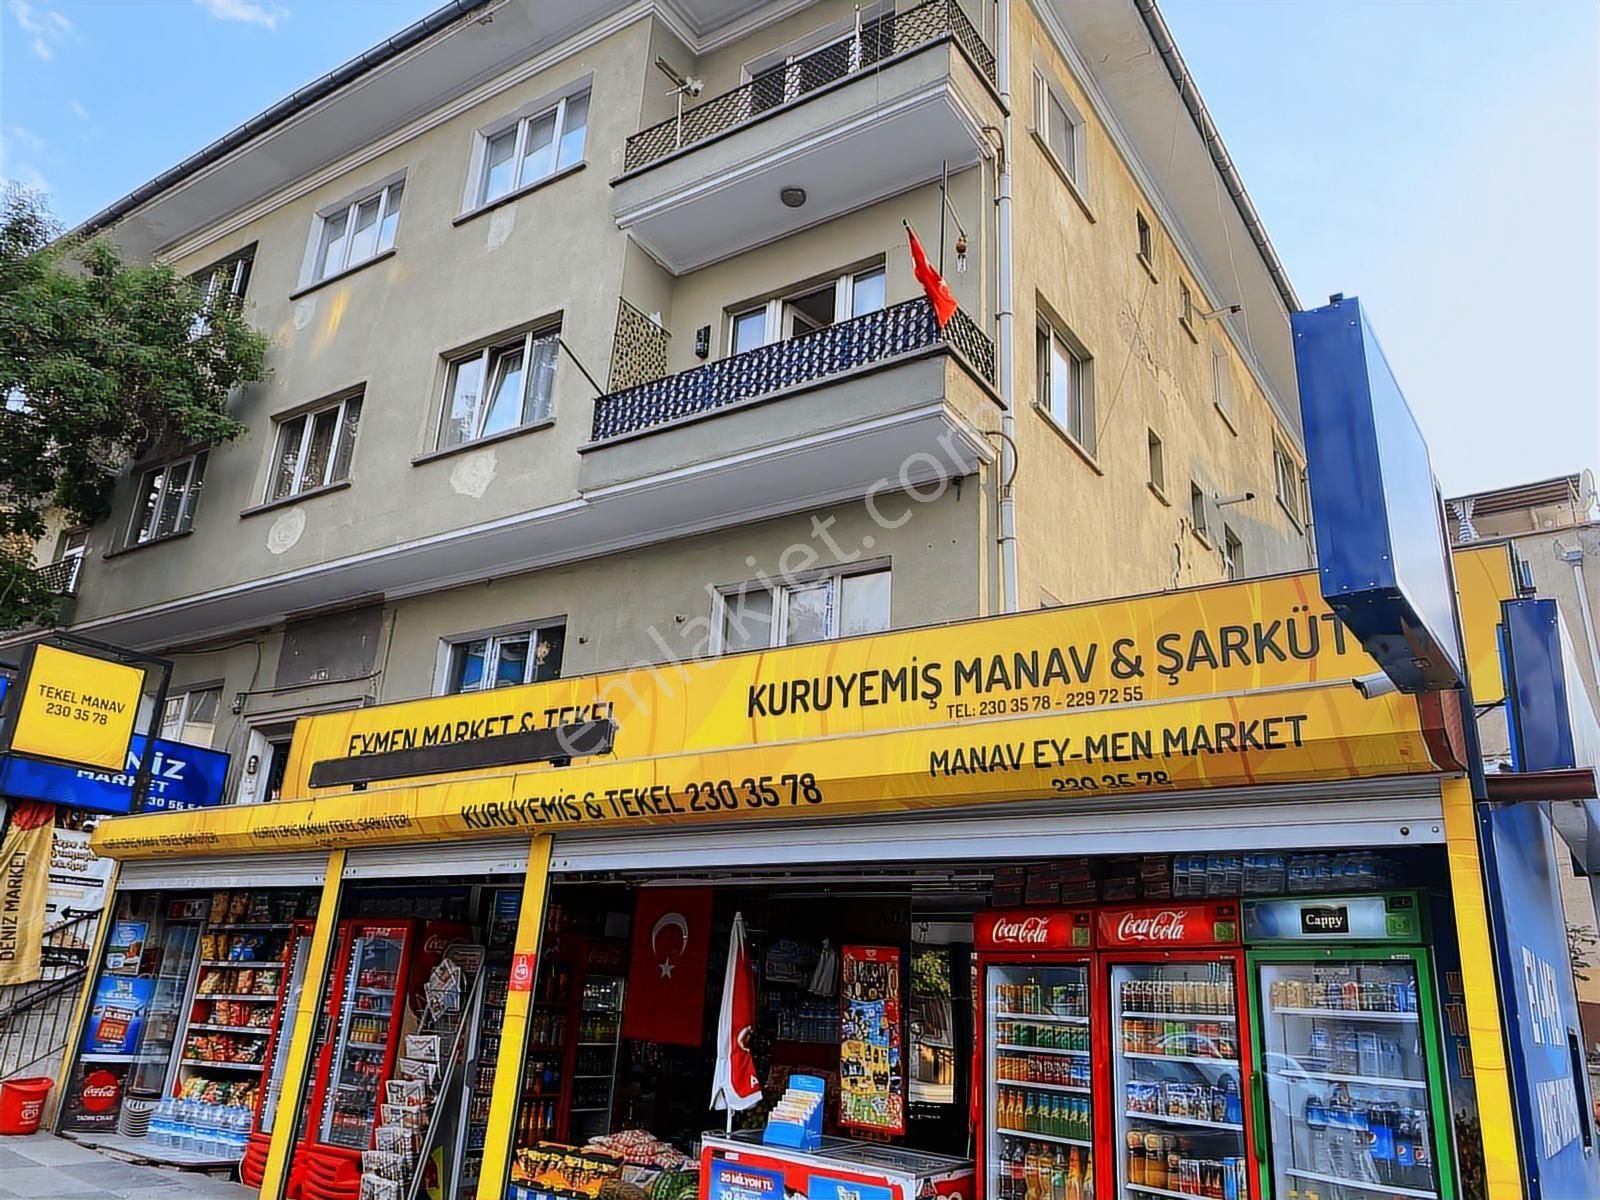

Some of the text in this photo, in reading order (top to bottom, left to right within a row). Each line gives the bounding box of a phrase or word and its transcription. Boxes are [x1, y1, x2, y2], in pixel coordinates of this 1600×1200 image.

[747, 656, 942, 718] KURUYEMİŞ
[953, 643, 1098, 697] MANAV
[1110, 638, 1145, 680] &
[39, 684, 127, 714] TEKEL MANAV
[45, 702, 108, 726] 230 35 78
[946, 704, 976, 720] TEL:
[979, 700, 1006, 716] 230
[1010, 697, 1028, 713] 35
[1032, 695, 1051, 711] 78
[1066, 691, 1095, 708] 229
[1100, 688, 1119, 704] 72
[1123, 686, 1144, 702] 55
[348, 727, 418, 758] EYMEN
[422, 714, 514, 747] MARKET
[519, 711, 536, 733] &
[929, 715, 1308, 778] MANAV EY-MEN MARKET
[460, 773, 823, 830] KURUYEMİŞ & TEKEL 230 35 78
[6, 851, 28, 913] MARKET
[992, 916, 1051, 944] Coca-Cola
[1117, 909, 1189, 942] Coca-Cola
[1305, 913, 1343, 928] Cappy
